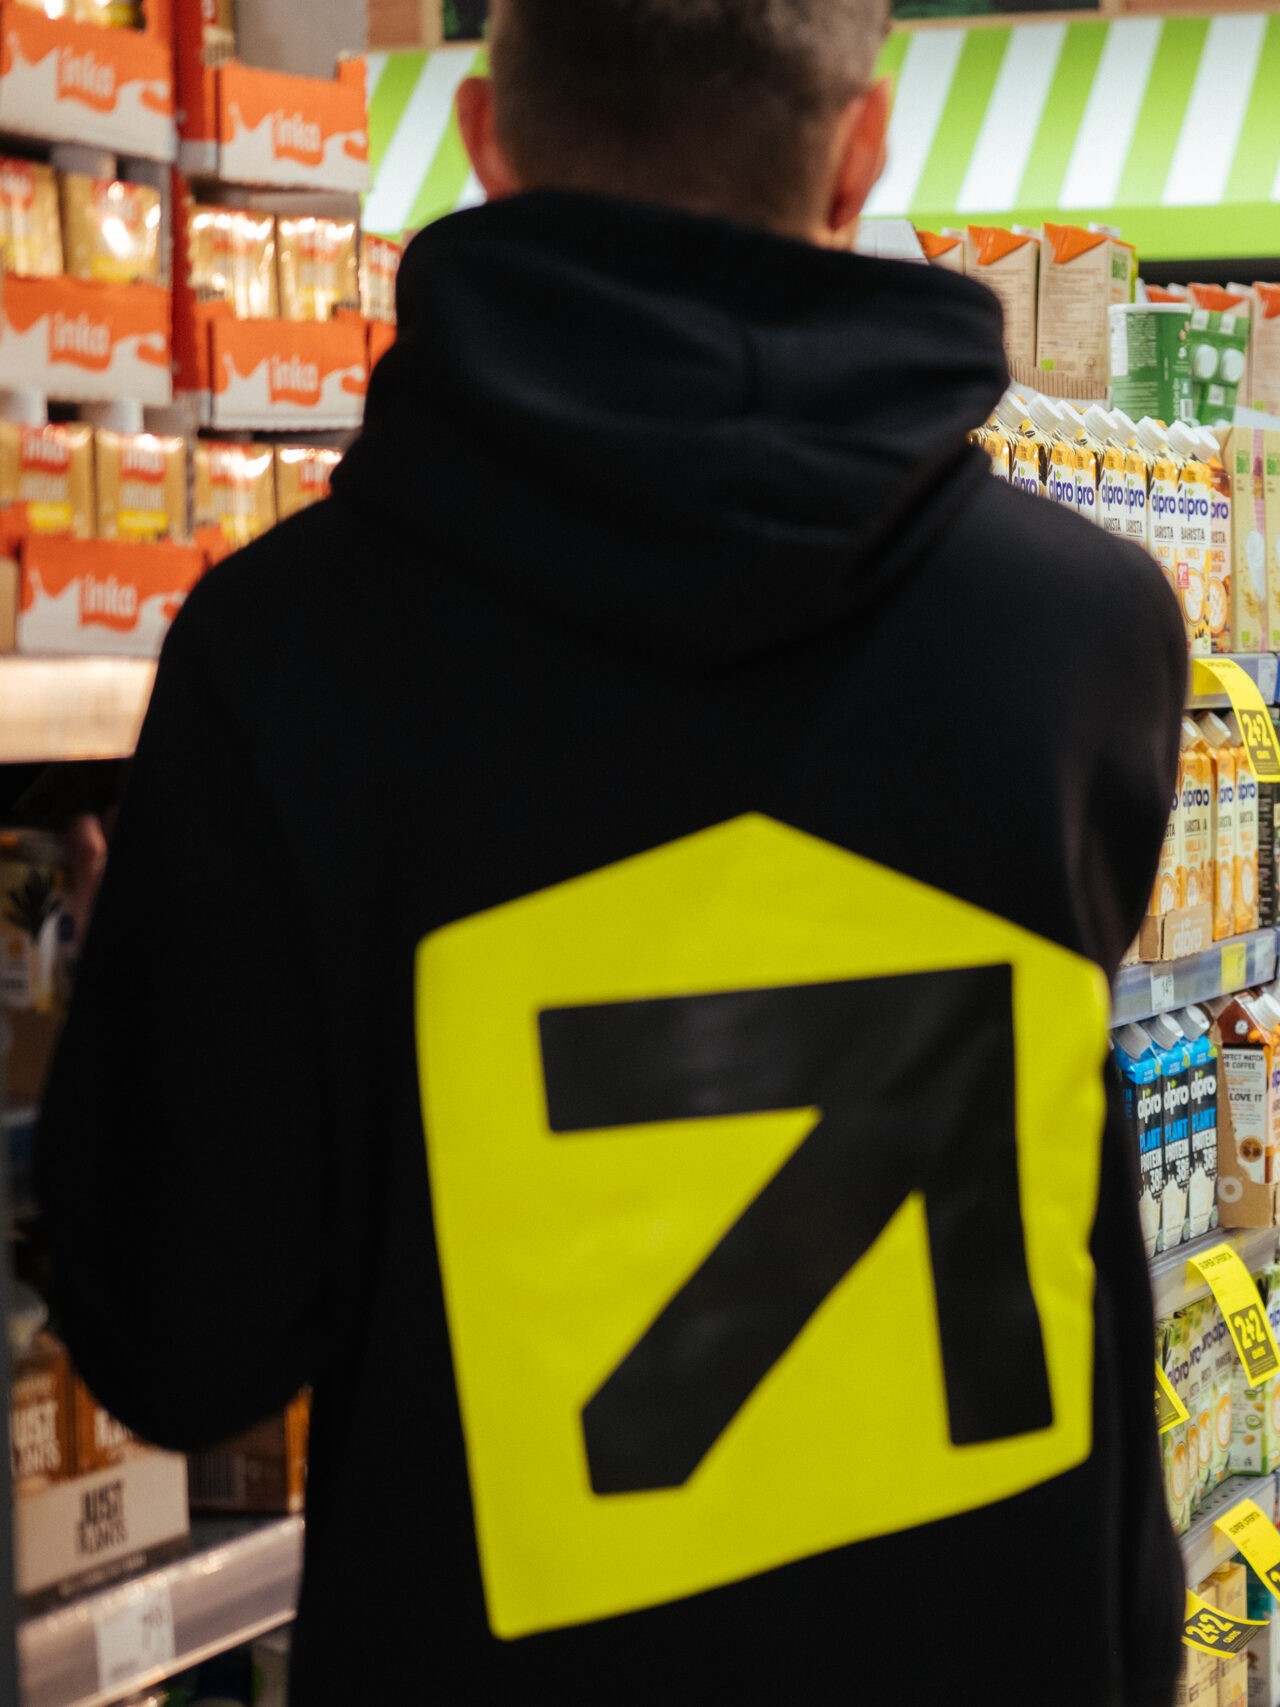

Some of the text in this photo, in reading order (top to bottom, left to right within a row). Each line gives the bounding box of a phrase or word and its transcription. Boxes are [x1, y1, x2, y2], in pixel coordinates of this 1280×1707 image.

[1075, 474, 1095, 512] lpro
[1101, 474, 1124, 511] alpro
[1152, 485, 1177, 519] alpro
[1178, 488, 1209, 522] alpro
[1242, 712, 1273, 748] 2+2
[1163, 1081, 1190, 1115] alpro
[1190, 1071, 1217, 1105] alpro
[1229, 1093, 1263, 1103] LOVE IT
[1138, 1089, 1162, 1124] alpro
[1191, 1107, 1217, 1134] PLANT
[1164, 1117, 1189, 1145] PLANT
[1233, 1308, 1267, 1350] 2+2
[1185, 1613, 1235, 1645] 2+2
